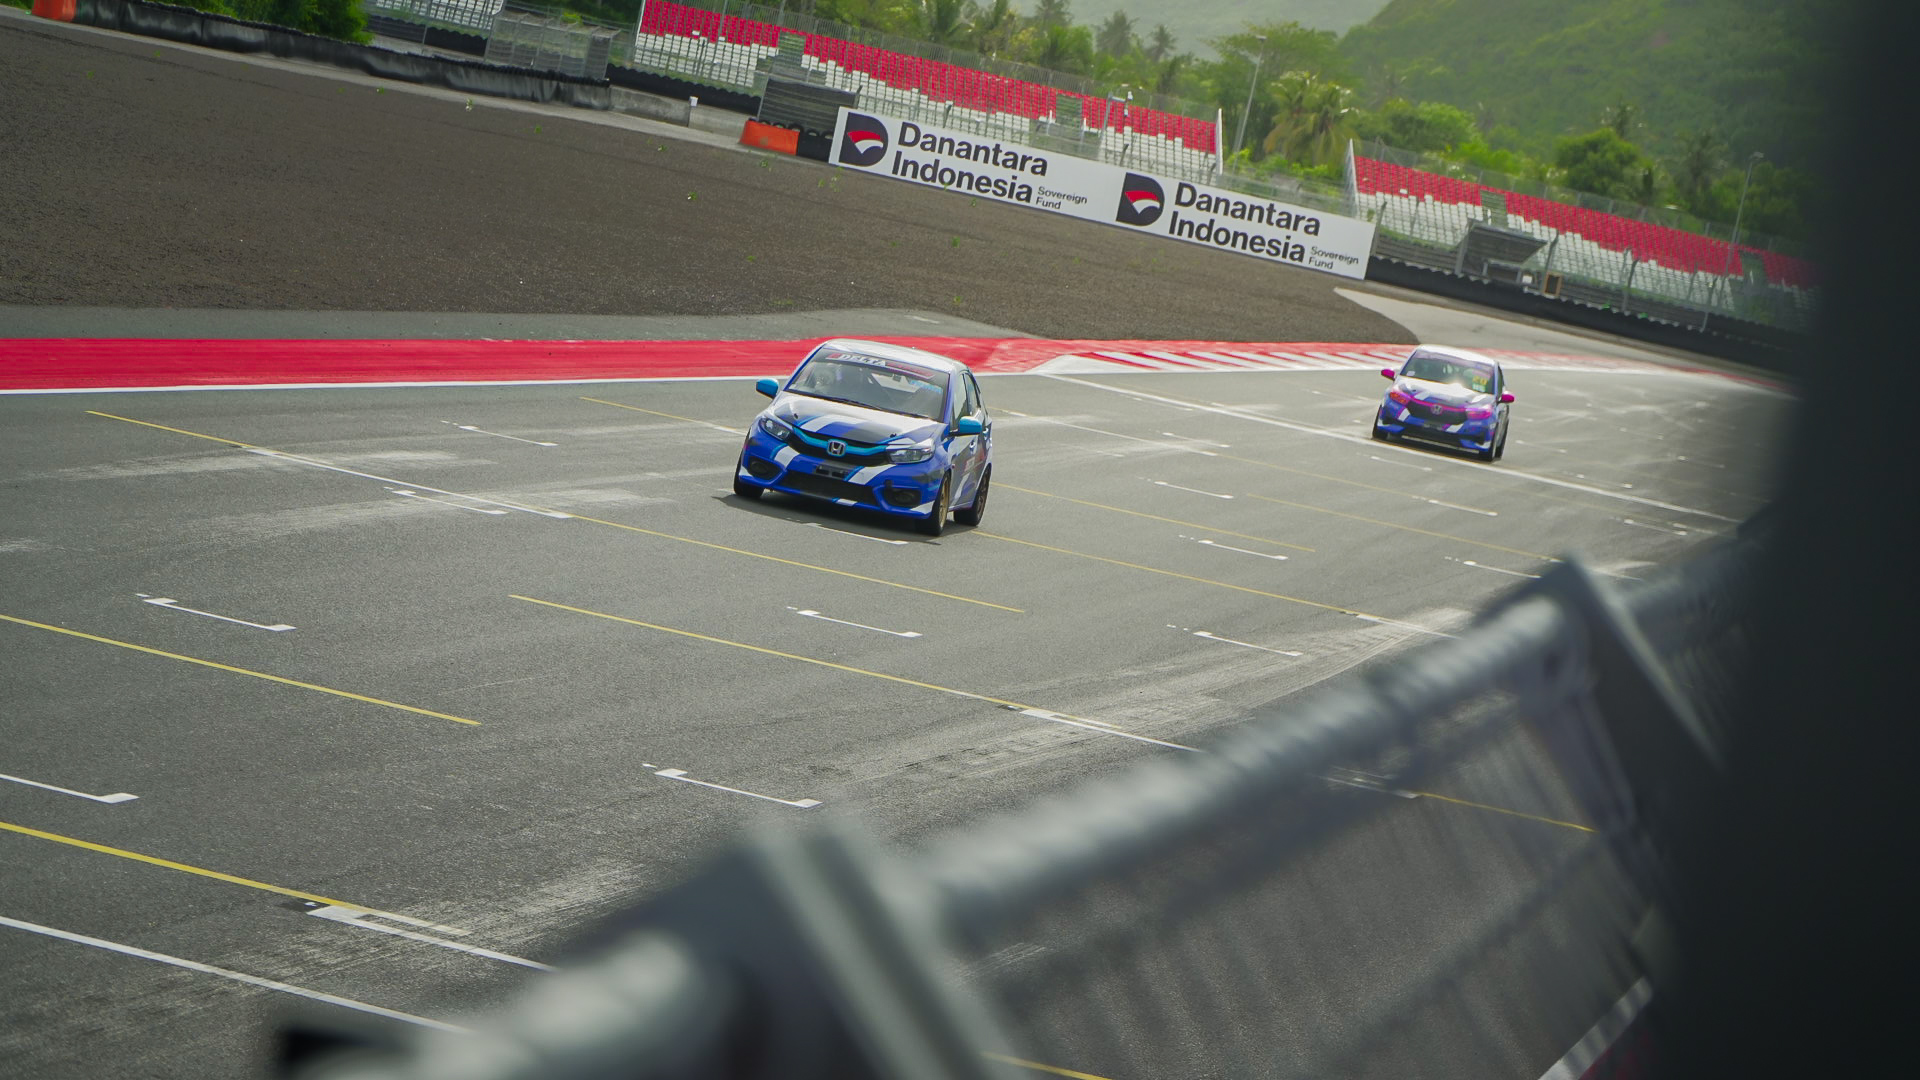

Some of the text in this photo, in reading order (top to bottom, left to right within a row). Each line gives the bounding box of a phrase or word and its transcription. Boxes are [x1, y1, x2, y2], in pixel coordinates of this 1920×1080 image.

[898, 121, 1048, 177] Danantara
[892, 151, 1033, 203] Indonesia
[1035, 197, 1061, 210] Fund
[1037, 186, 1088, 205] Sovereign
[1175, 182, 1321, 237] Danantara
[1168, 211, 1306, 263] Indonesia
[1308, 257, 1333, 270] Fund
[1310, 246, 1359, 265] Sovereign
[839, 353, 886, 367] DELTA
